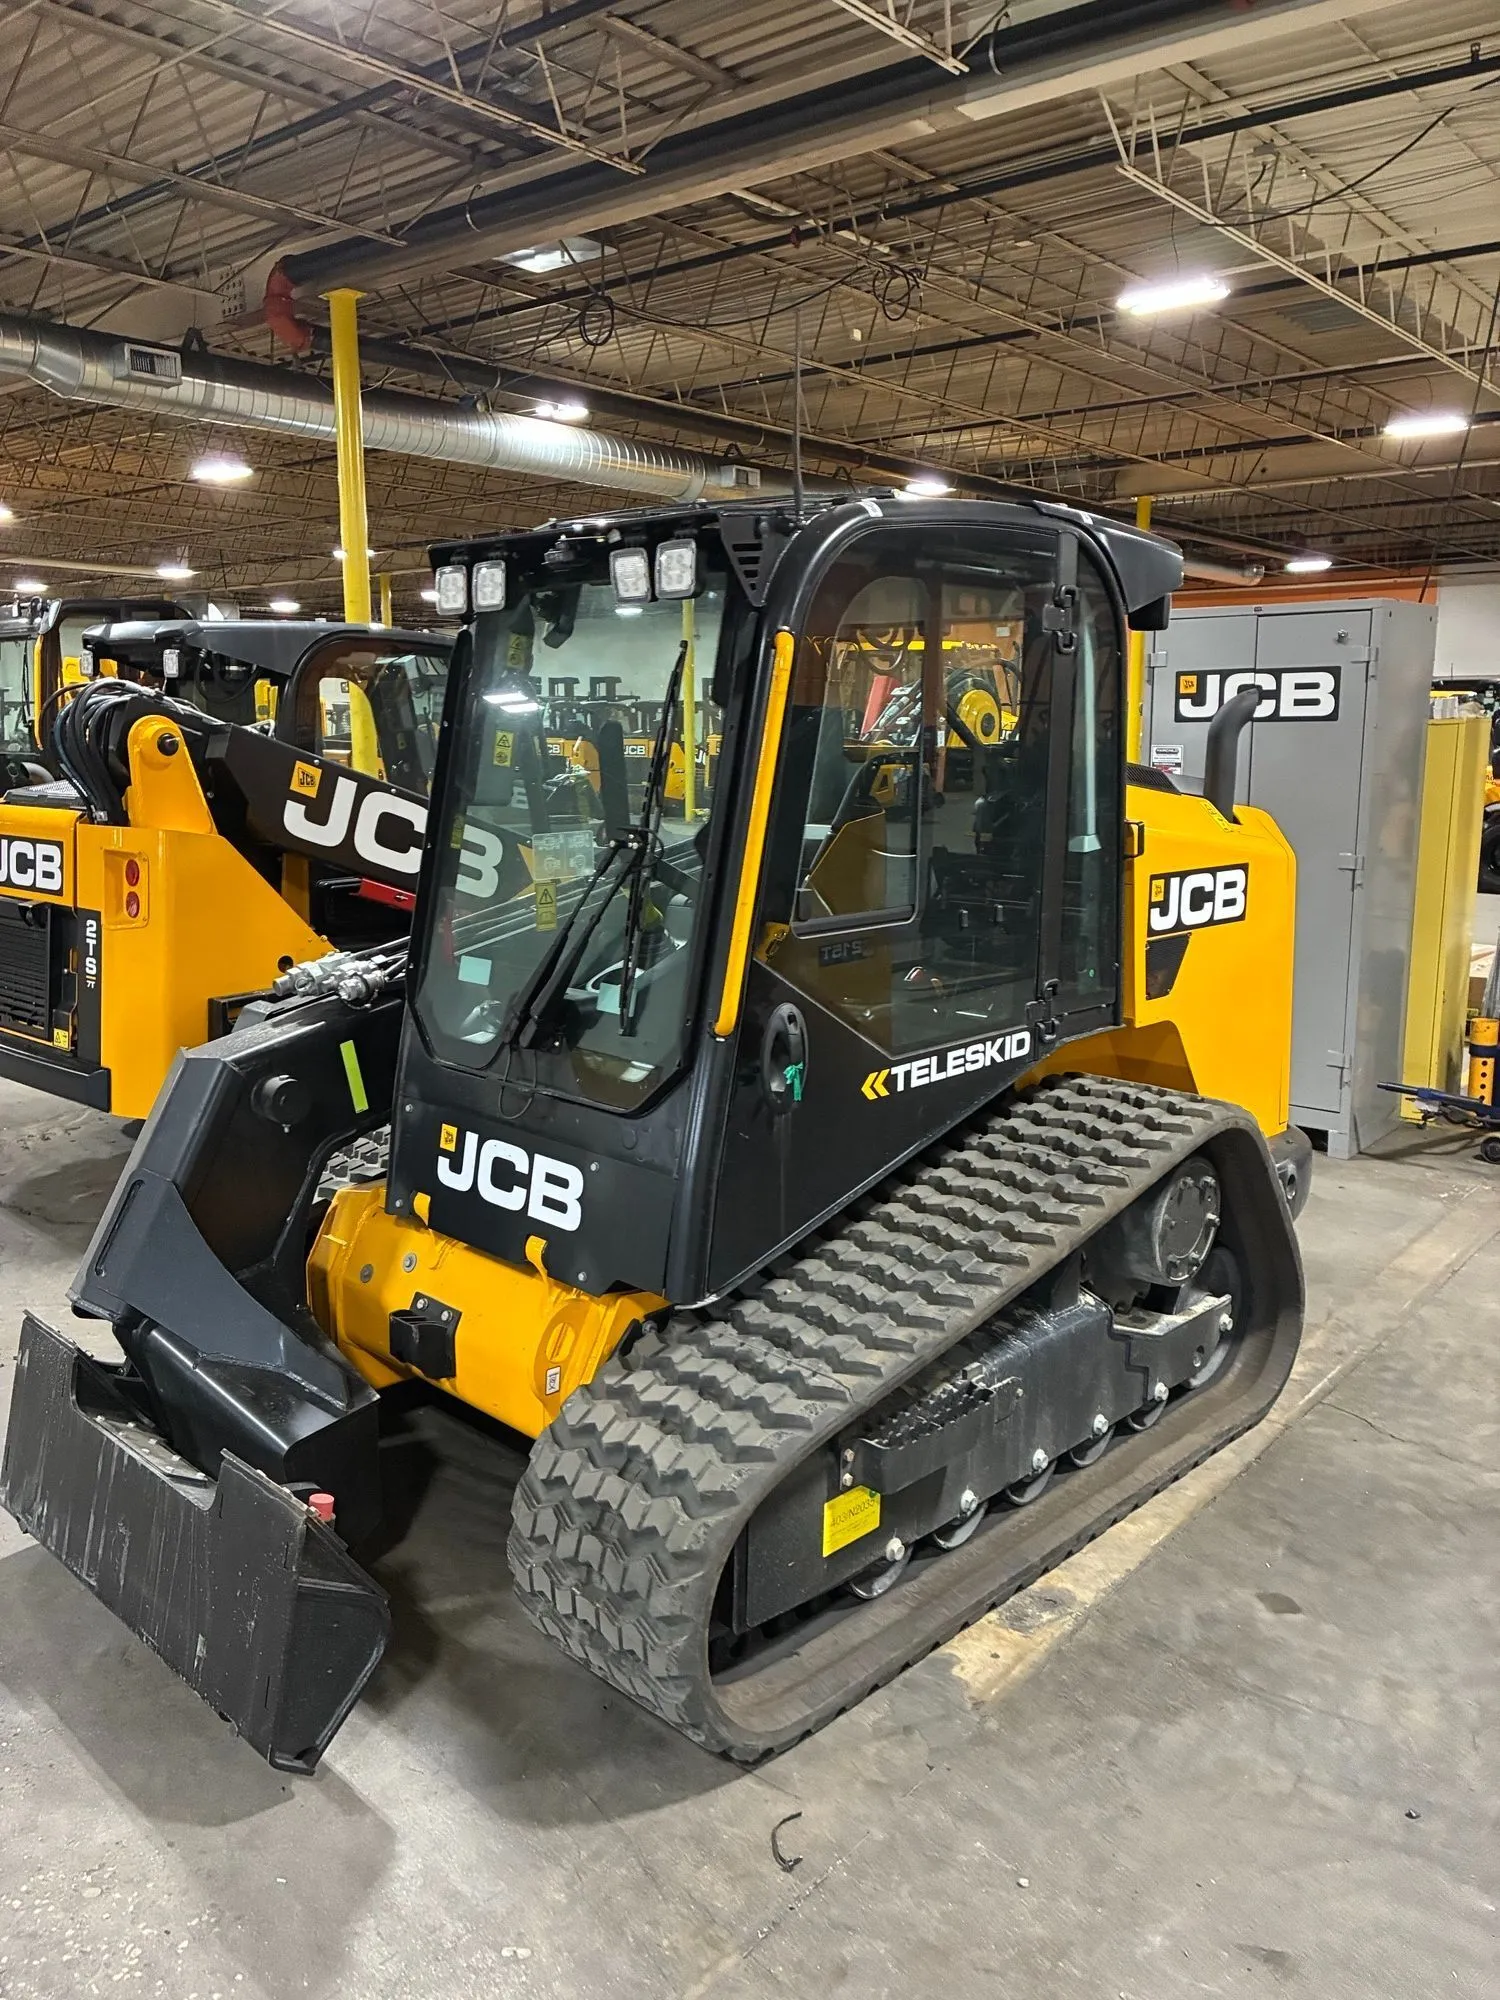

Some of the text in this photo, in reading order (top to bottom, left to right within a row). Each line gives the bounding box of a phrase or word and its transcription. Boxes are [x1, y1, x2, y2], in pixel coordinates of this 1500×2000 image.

[1179, 671, 1335, 718] JCB
[1149, 868, 1246, 931] JCB
[891, 1031, 1031, 1092] TELESKID
[437, 1131, 584, 1231] JCB
